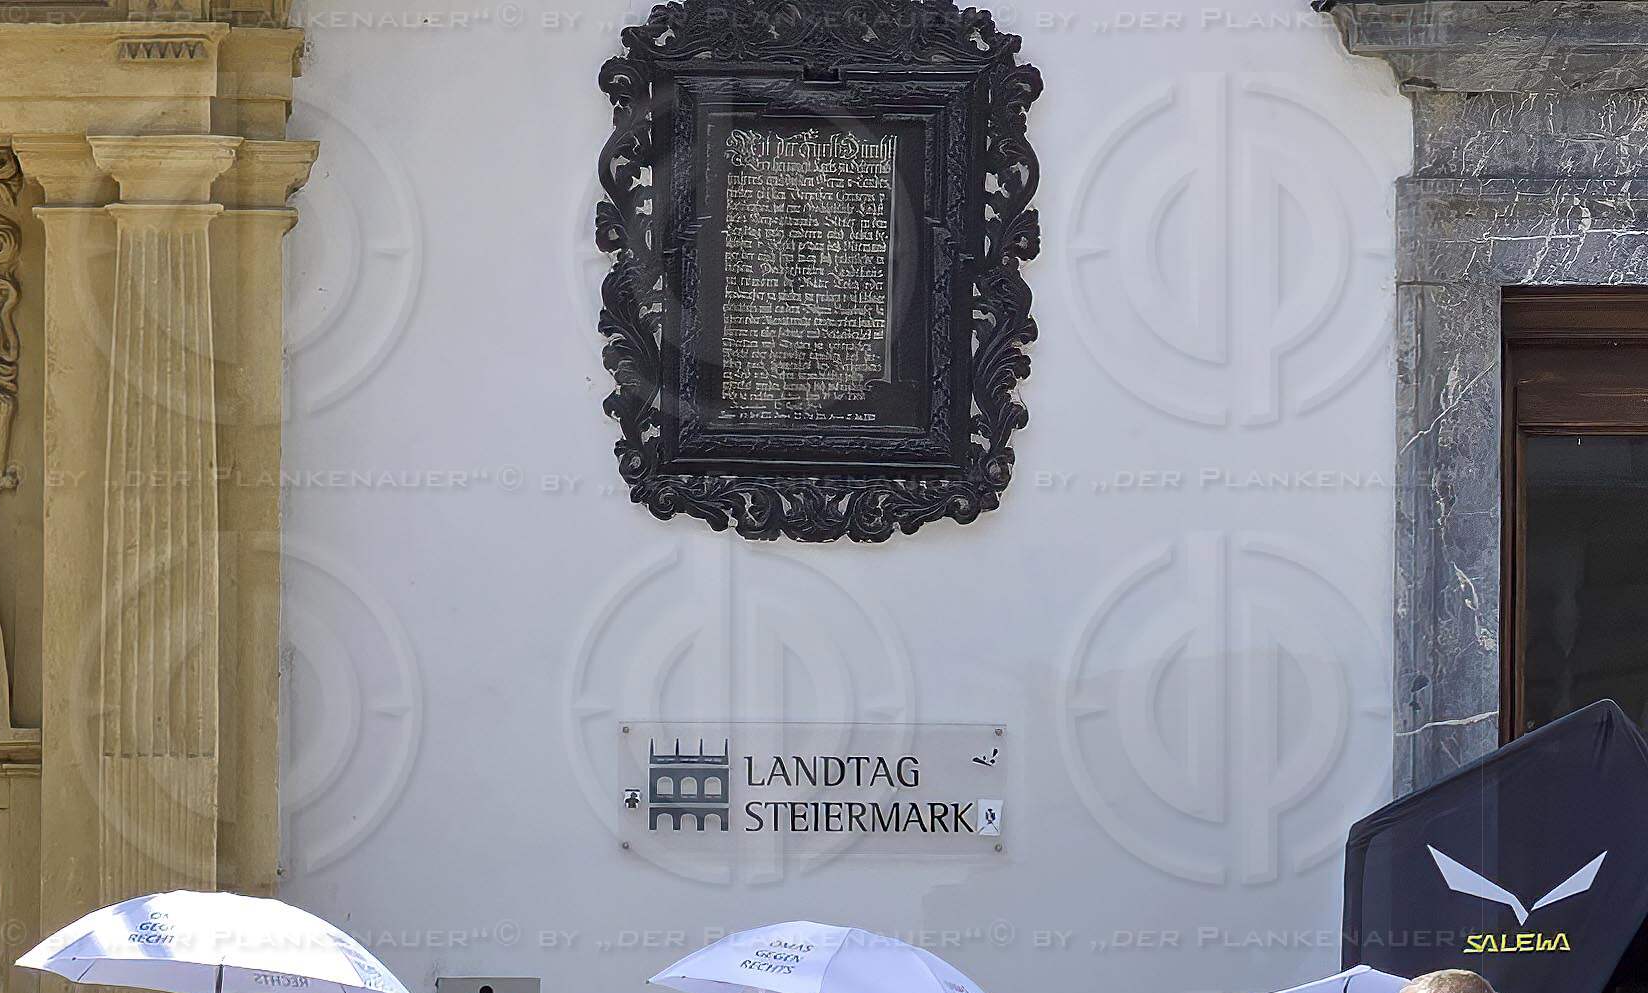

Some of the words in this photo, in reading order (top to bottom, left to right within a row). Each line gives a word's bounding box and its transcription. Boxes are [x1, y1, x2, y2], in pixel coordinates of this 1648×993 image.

[744, 756, 920, 788] LANDTAG
[745, 802, 974, 832] STEIERMARK
[128, 933, 175, 944] RECHT
[1463, 933, 1570, 953] SALEWA
